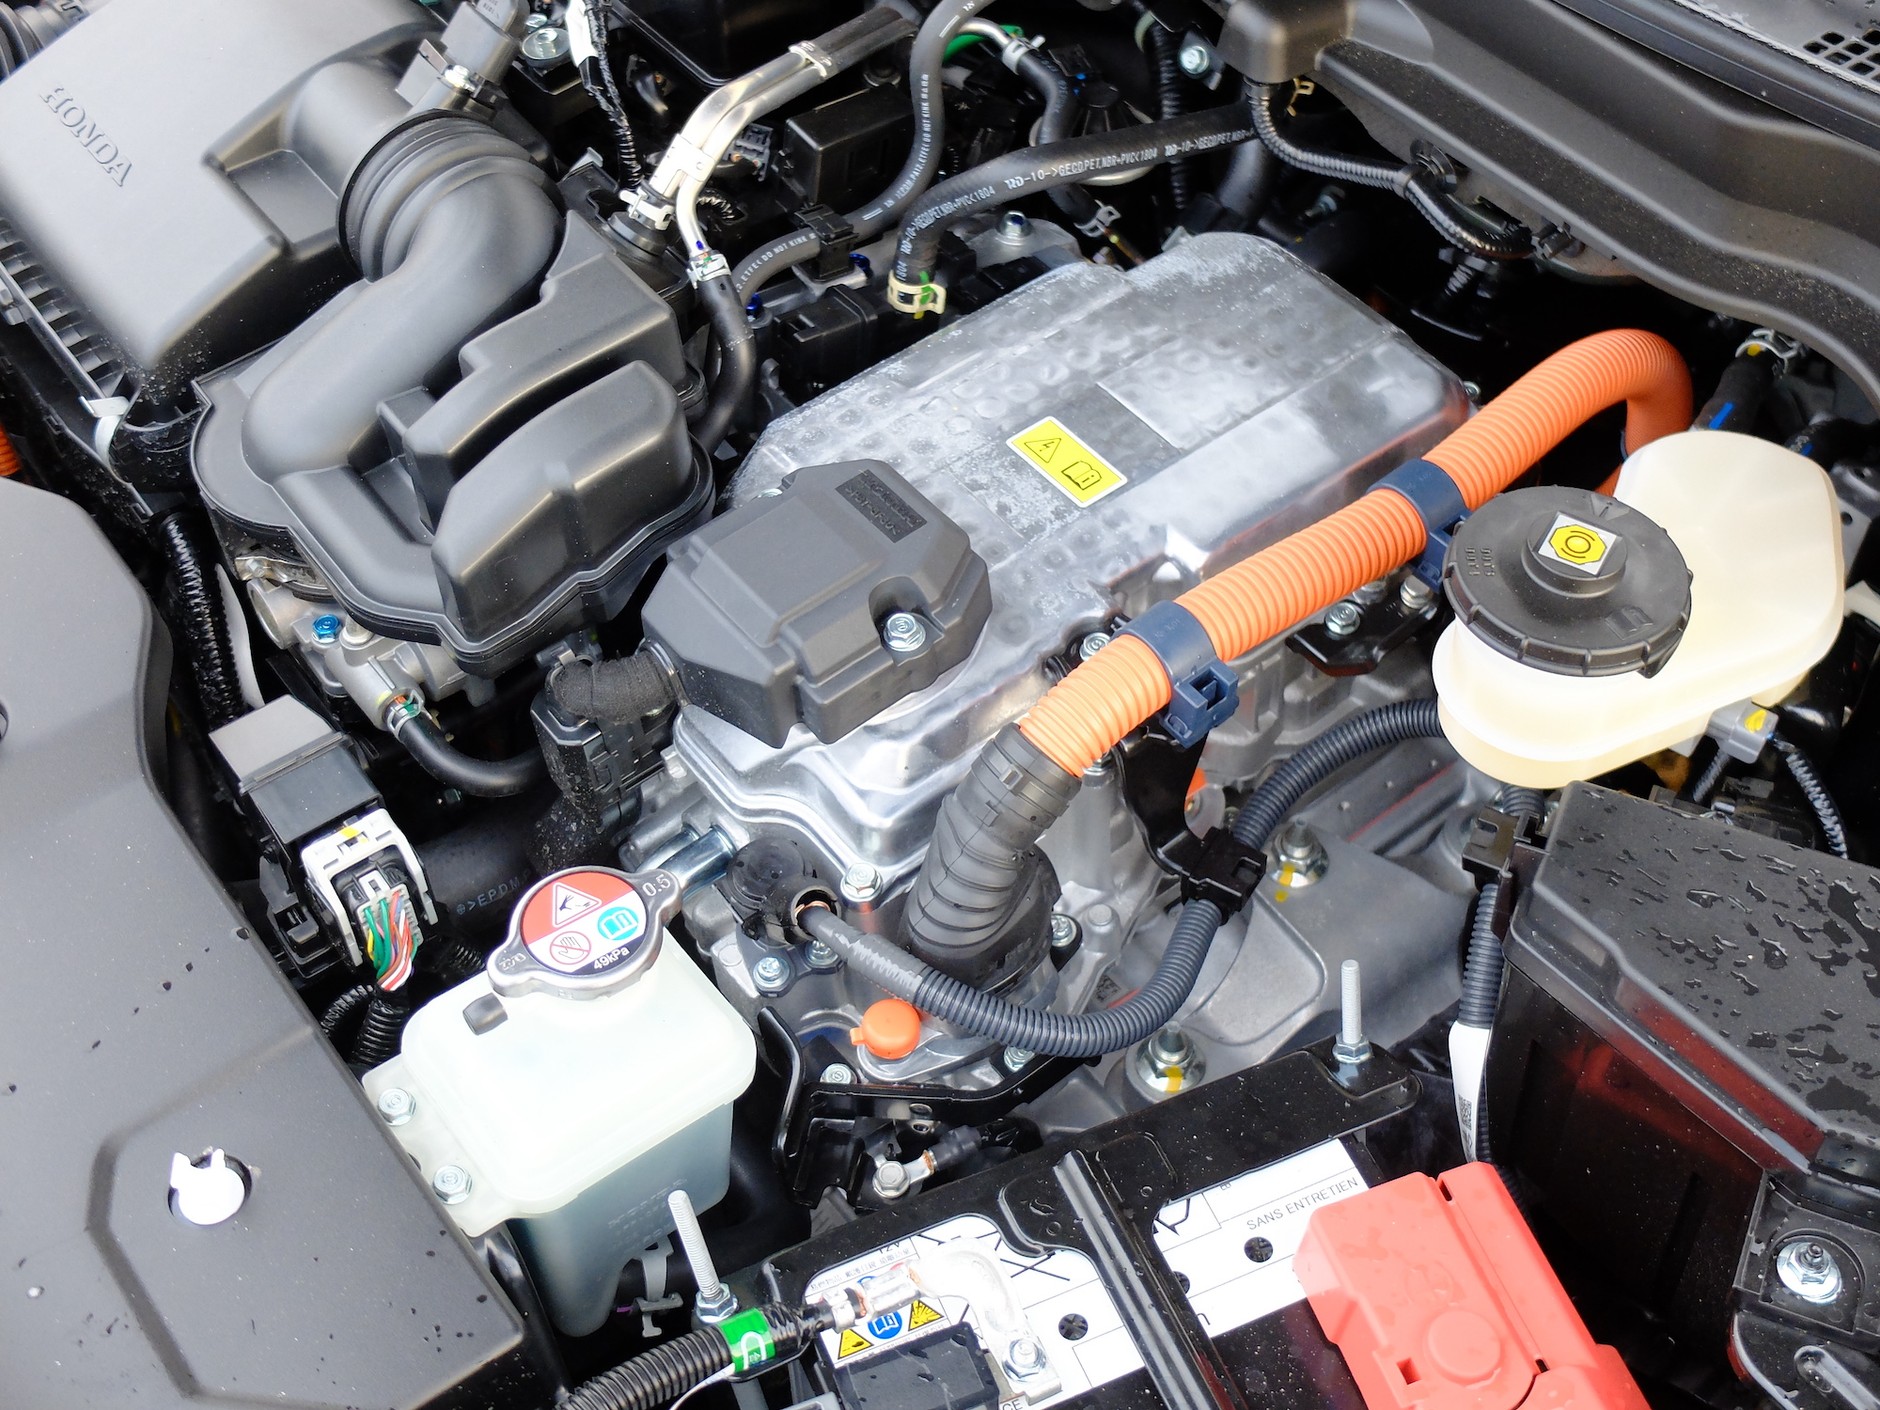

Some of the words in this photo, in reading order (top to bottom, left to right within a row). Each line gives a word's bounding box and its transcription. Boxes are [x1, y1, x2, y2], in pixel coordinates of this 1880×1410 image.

[921, 102, 930, 118] KINK
[39, 86, 132, 187] HONDA
[922, 119, 931, 132] NOT
[922, 133, 932, 142] DO
[761, 251, 774, 262] DO
[773, 243, 788, 254] NOT
[788, 235, 808, 247] KINK
[593, 945, 631, 970] 49kPa
[1246, 1208, 1284, 1231] SANS
[1287, 1177, 1359, 1214] ENTRETIEN
